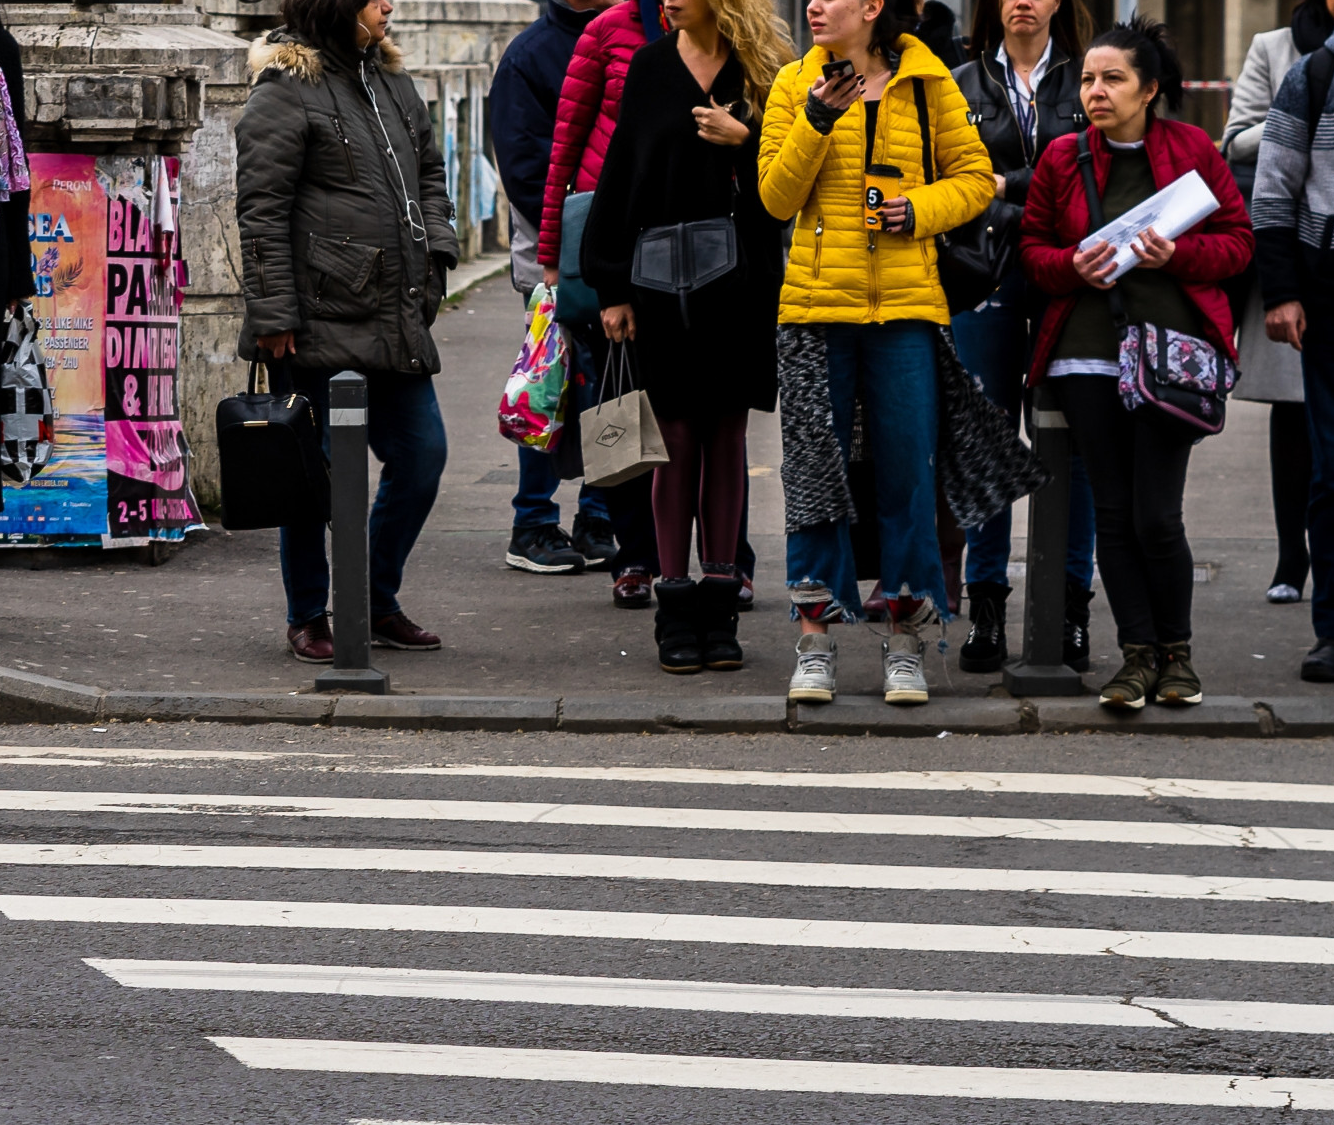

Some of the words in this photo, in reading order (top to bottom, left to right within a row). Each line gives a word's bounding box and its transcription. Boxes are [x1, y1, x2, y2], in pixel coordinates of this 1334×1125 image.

[52, 179, 92, 191] PERONI
[869, 189, 877, 204] 5
[54, 317, 72, 330] LIKE
[74, 318, 93, 331] MIKE
[44, 337, 89, 351] PASSENGER
